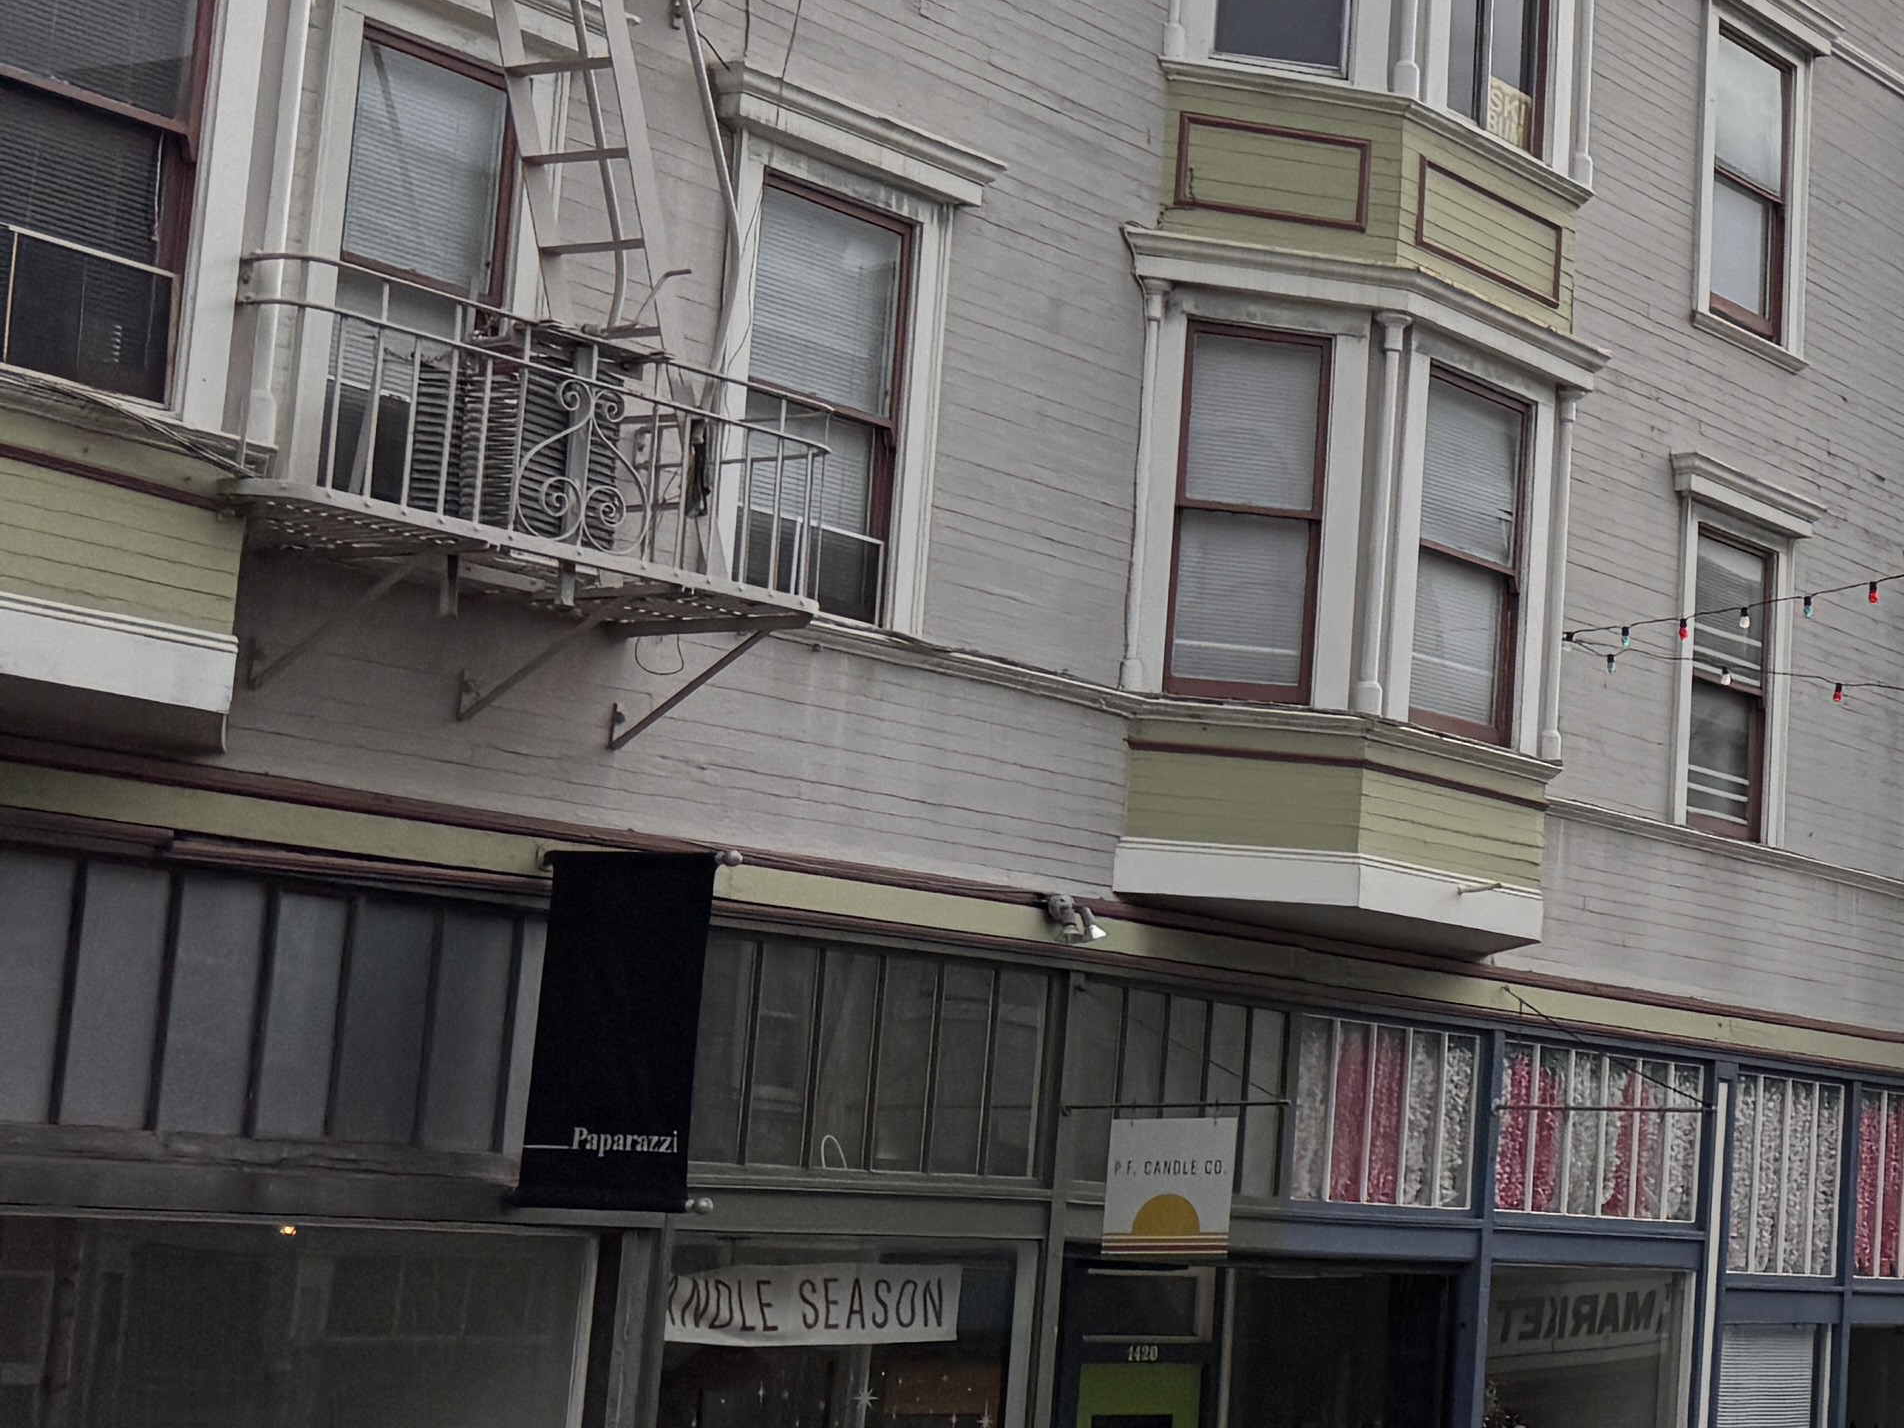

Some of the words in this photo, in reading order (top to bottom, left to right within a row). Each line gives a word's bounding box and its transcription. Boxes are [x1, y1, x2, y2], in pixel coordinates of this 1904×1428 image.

[572, 1126, 678, 1158] Paparazzi
[1144, 1158, 1198, 1176] CANDLE
[799, 1277, 944, 1330] SEASON
[1127, 1344, 1159, 1363] 1420
